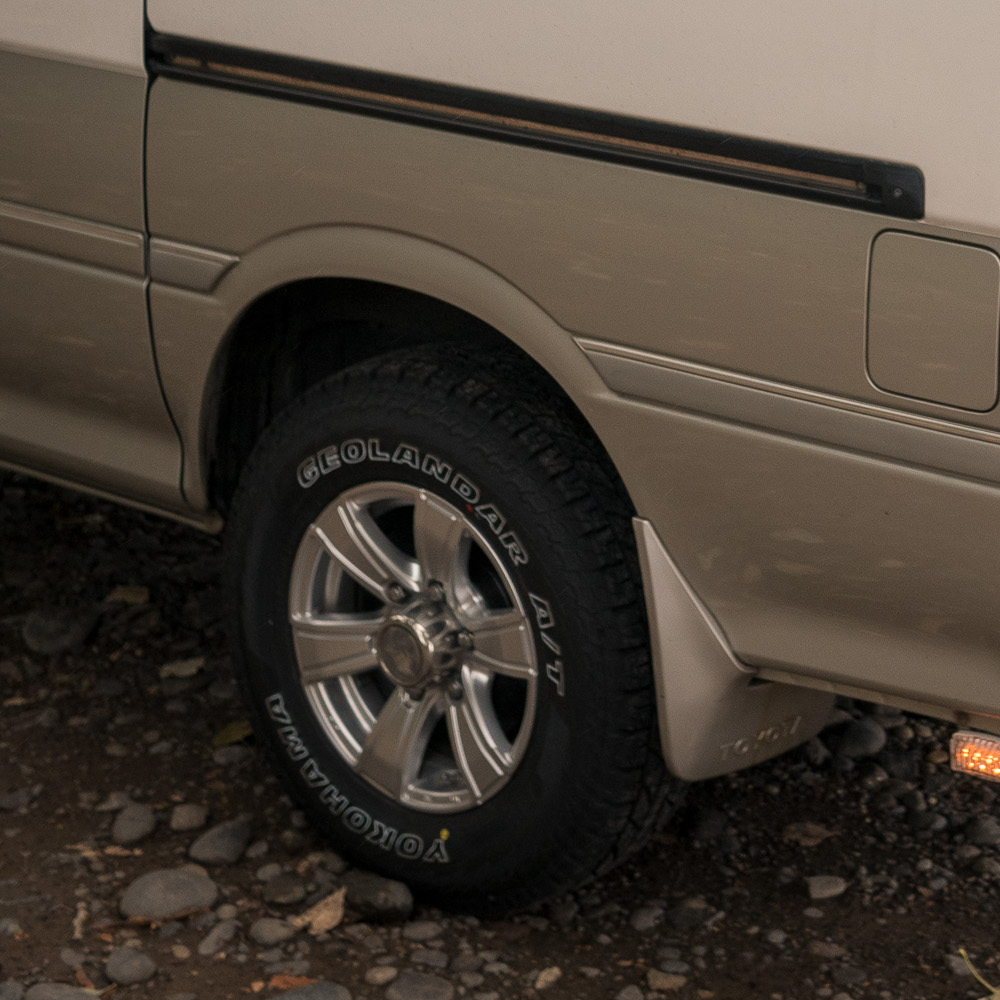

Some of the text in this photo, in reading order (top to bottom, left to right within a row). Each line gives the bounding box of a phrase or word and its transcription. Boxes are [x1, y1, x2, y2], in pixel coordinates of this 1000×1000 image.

[297, 438, 566, 696] GEOLANDAR A/T
[264, 693, 451, 864] YOKOHAMA
